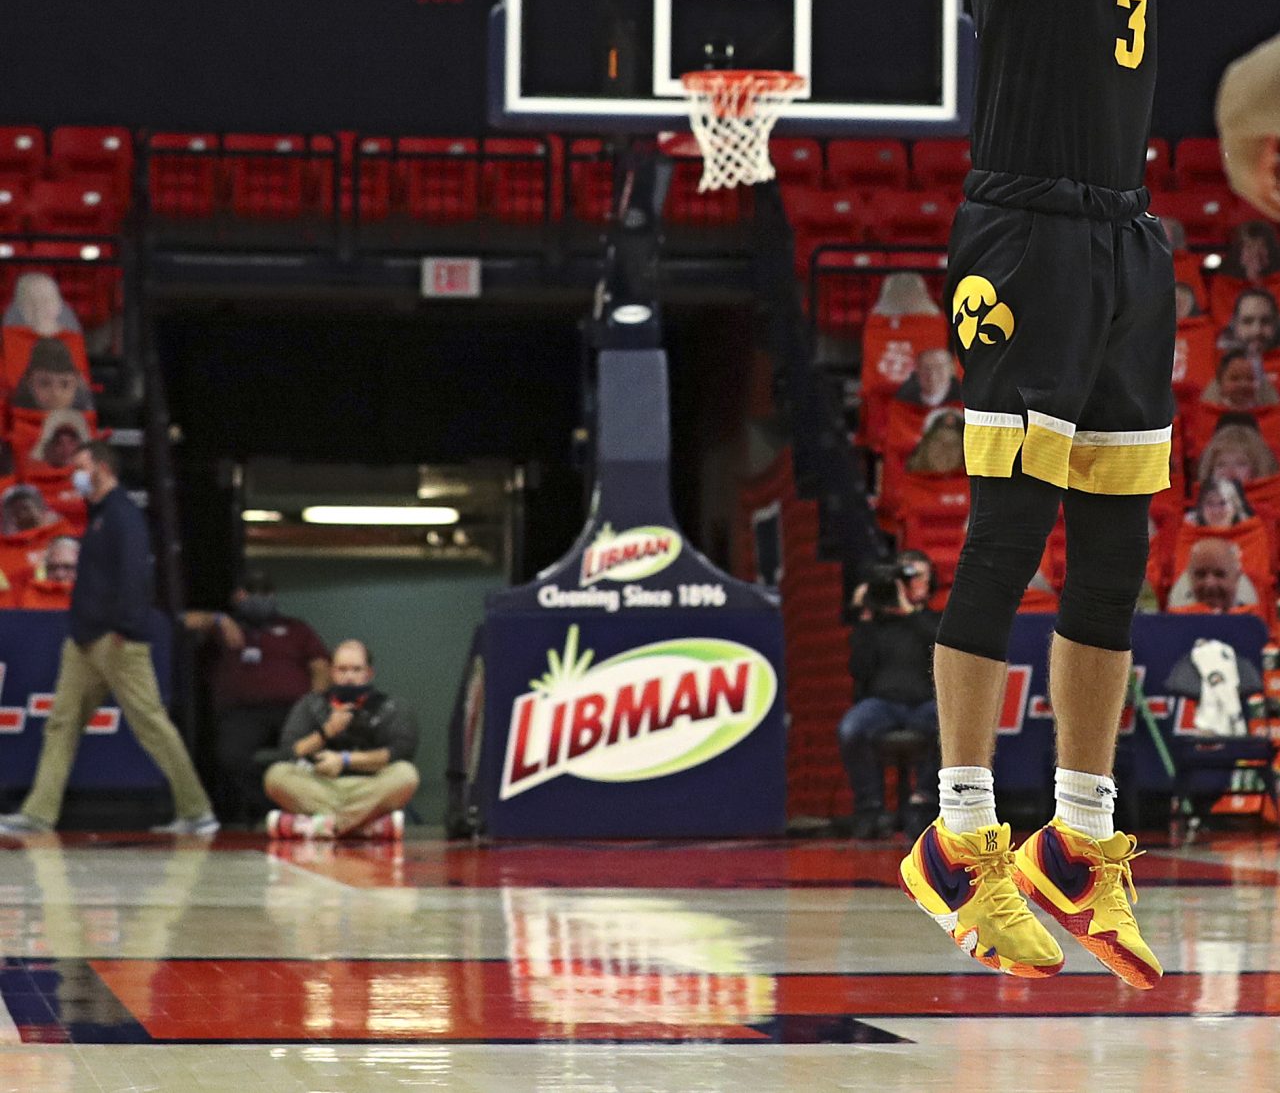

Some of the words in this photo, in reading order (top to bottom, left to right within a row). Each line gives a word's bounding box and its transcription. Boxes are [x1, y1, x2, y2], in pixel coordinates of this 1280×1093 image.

[582, 537, 671, 579] LIBMAN
[537, 584, 621, 612] Cleaning
[622, 584, 673, 607] Since
[678, 583, 727, 607] 1896
[509, 661, 751, 785] LIBMAN
